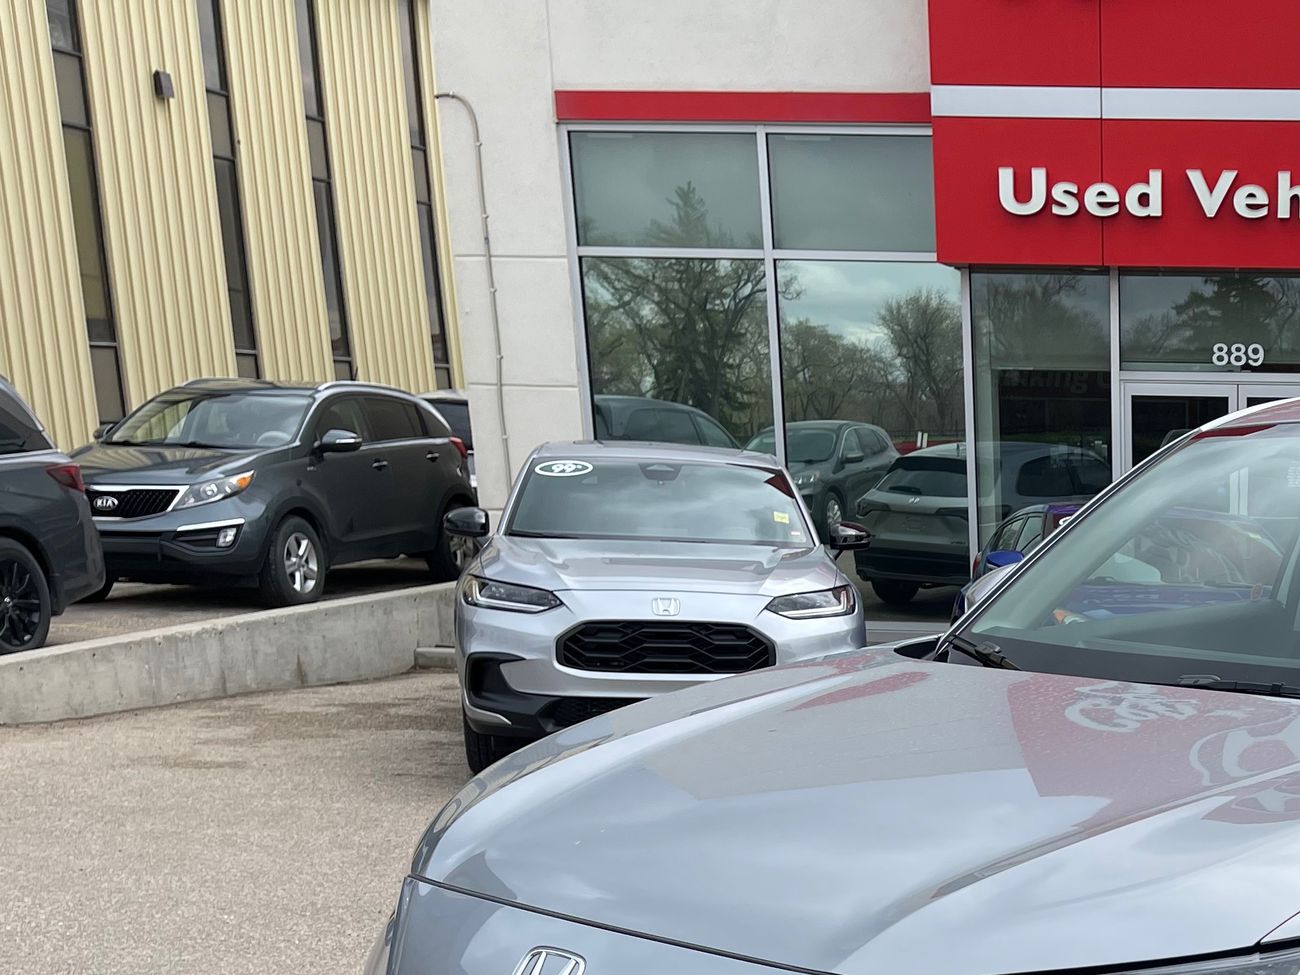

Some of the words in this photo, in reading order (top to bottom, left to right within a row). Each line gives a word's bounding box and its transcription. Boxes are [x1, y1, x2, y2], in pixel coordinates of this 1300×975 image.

[998, 166, 1163, 218] Used
[1211, 342, 1265, 367] 889
[96, 497, 114, 509] KIA
